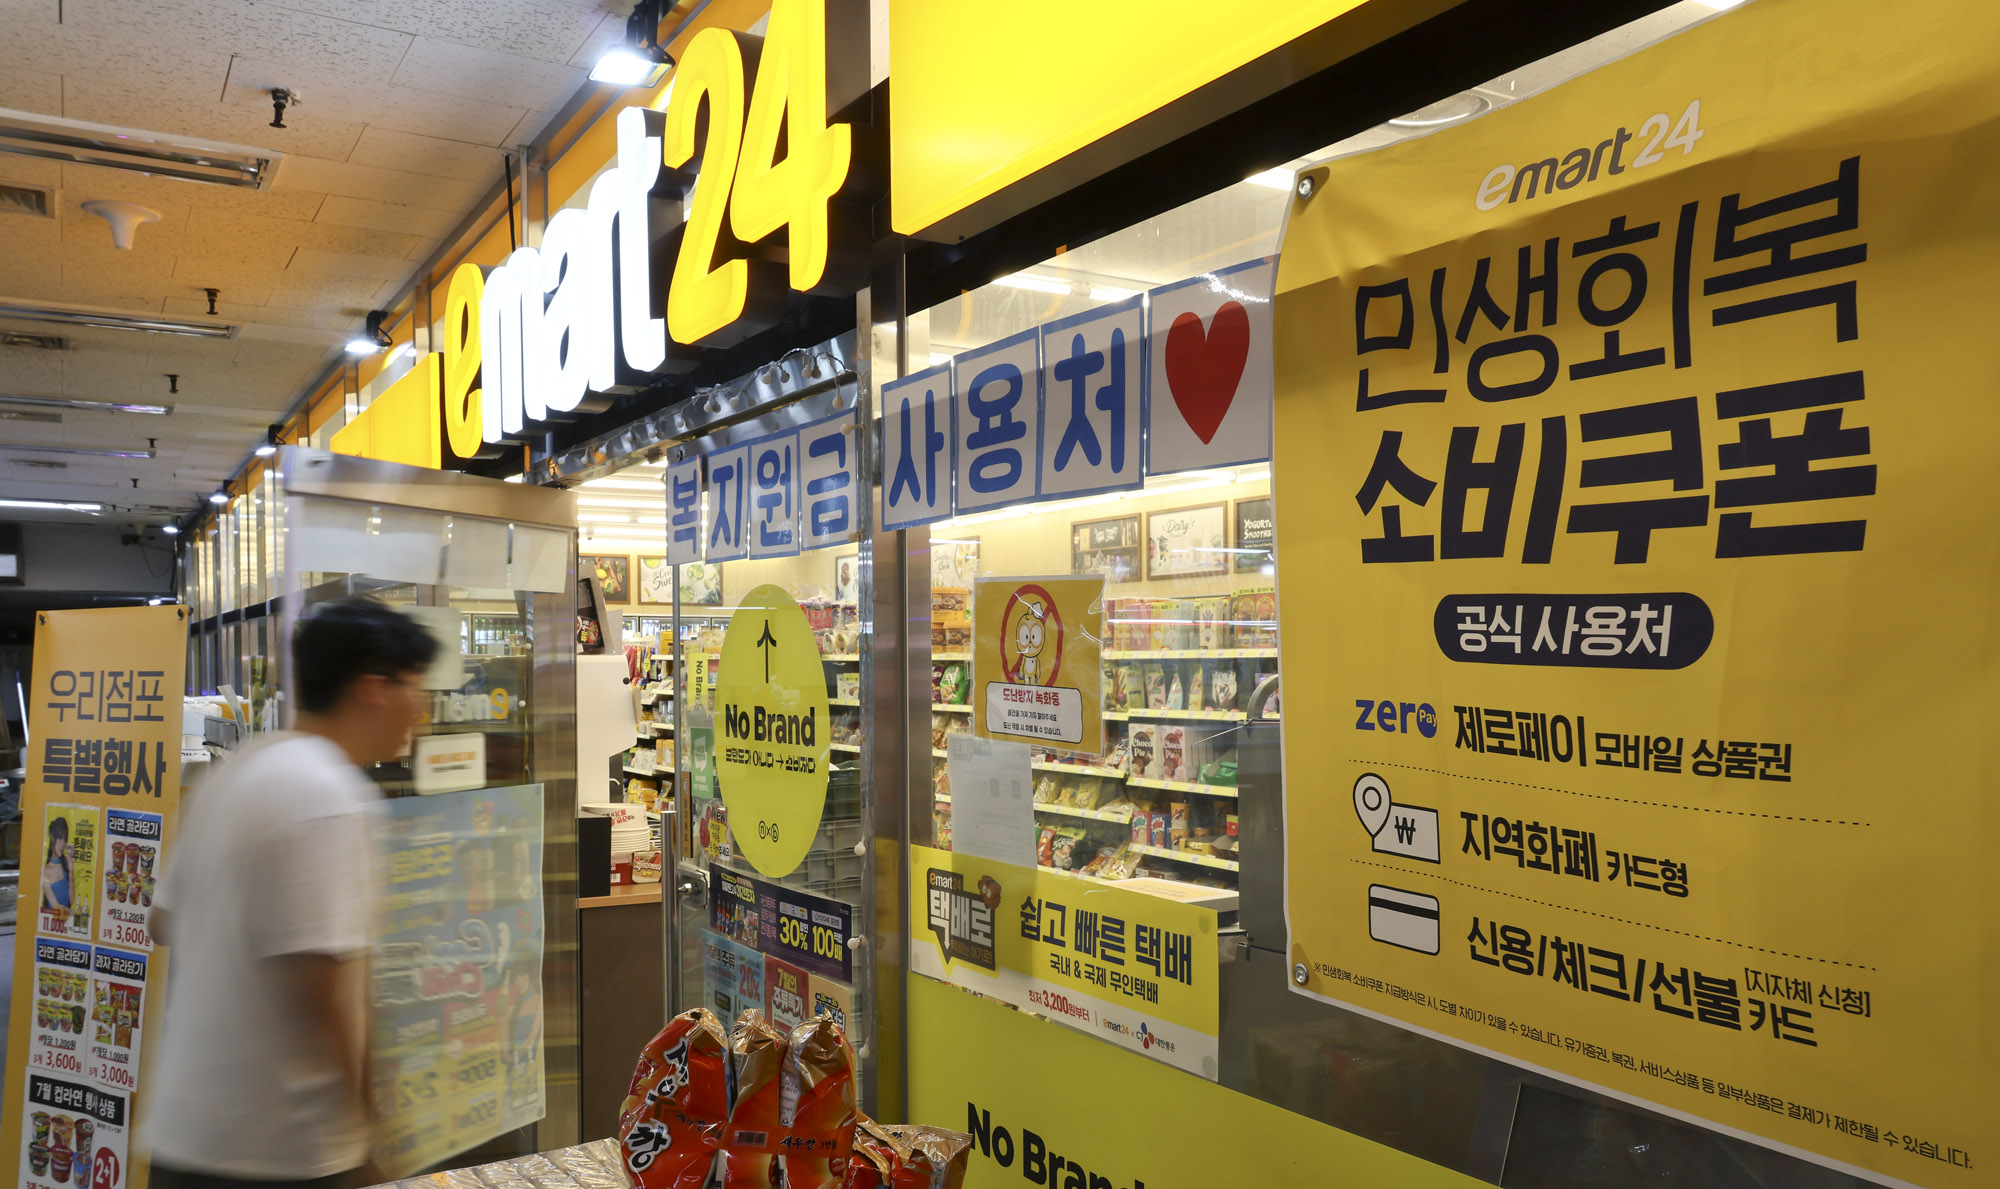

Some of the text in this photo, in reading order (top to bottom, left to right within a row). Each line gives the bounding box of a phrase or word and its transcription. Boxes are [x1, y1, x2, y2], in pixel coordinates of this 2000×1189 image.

[1475, 100, 1704, 211] emart24
[444, 0, 852, 459] emart24
[1355, 155, 1867, 412] 민생회복
[672, 327, 1125, 555] 복지원금 사용처
[1355, 370, 1877, 565] 소비쿠폰
[1456, 603, 1672, 657] 공식 사용처
[48, 670, 164, 722] 우리점포
[1003, 687, 1060, 706] 도난방지 녹화중
[1355, 698, 1438, 738] zero
[725, 704, 815, 746] No Brand
[1453, 705, 1793, 783] 제로페이 모바일 상품권
[42, 737, 166, 798] 특별행사
[109, 817, 127, 830] 라면
[127, 819, 158, 836] 골라담기
[1460, 810, 1689, 898] 지역화폐 카드형
[779, 916, 808, 951] 30%
[930, 889, 992, 948] 택배로
[1020, 896, 1192, 986] 쉽고 빠른 택배
[38, 945, 88, 965] 라면 골라담기
[96, 954, 143, 976] 과자 골라담기
[1050, 952, 1158, 1004] 국내 & 국제 무인택배
[1466, 916, 1818, 1047] 신용/체크/선불 카드
[739, 963, 761, 1002] 20%
[1744, 966, 1871, 1017] [지자체 신청]
[1103, 1018, 1129, 1036] emart24
[1322, 964, 1352, 984] 민생회복
[1353, 972, 1384, 993] 소비쿠폰
[1385, 982, 1426, 1007] 지급방식은
[1439, 1000, 1458, 1016] 도별
[1459, 1006, 1487, 1025] 차이가
[1508, 1020, 1519, 1034] 수
[1520, 1024, 1563, 1049] 있습니다.
[1564, 1037, 1610, 1064] 유가증권,
[1611, 1052, 1637, 1072] 복권,
[1640, 1060, 1700, 1090] 서비스상품
[1702, 1078, 1715, 1095] 등
[1717, 1082, 1785, 1115] 일부상품은
[1787, 1102, 1831, 1129] 결제가
[1834, 1115, 1879, 1143] 제한될
[1883, 1130, 1899, 1148] 수
[1902, 1135, 1973, 1169] 있습니다.
[968, 1101, 1014, 1168] No
[96, 1156, 115, 1188] 2+1
